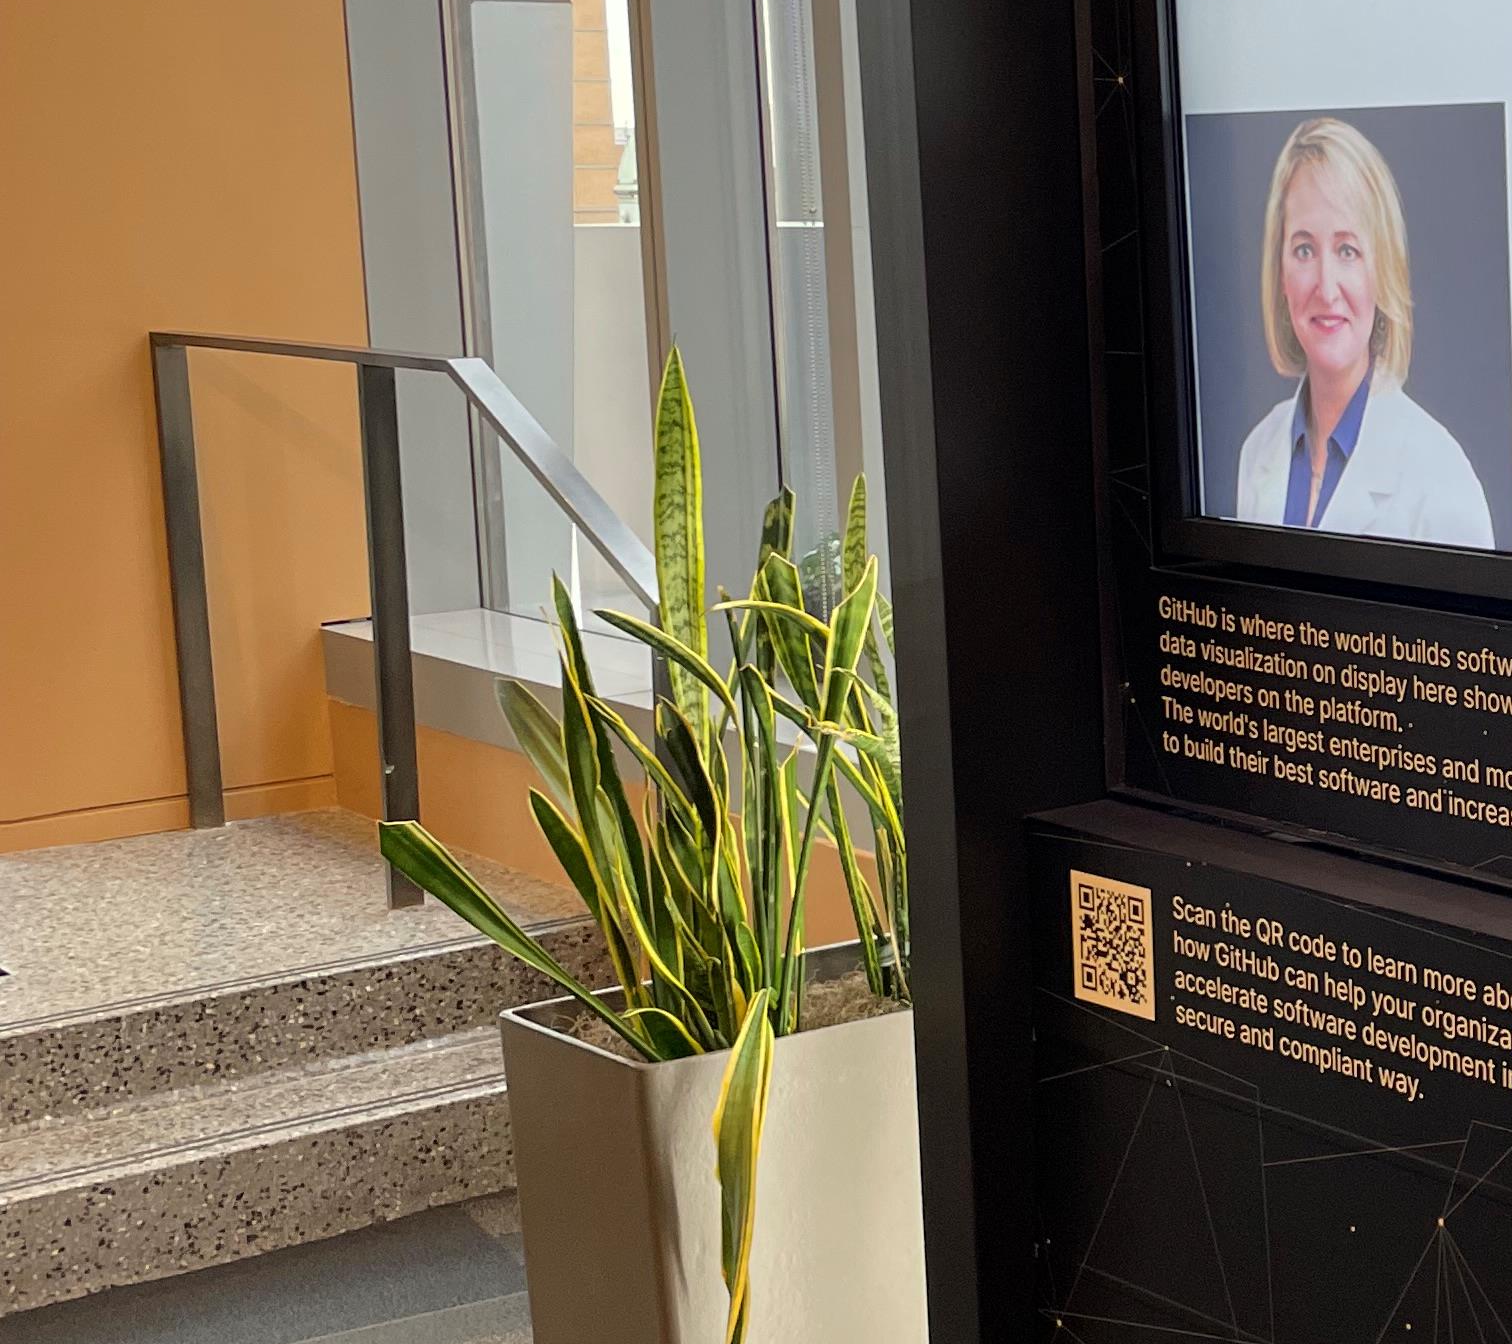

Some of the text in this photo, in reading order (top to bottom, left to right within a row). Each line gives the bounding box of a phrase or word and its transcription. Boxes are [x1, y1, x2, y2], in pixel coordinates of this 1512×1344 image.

[1159, 595, 1217, 628] GitHub
[1221, 608, 1235, 631] is
[1241, 613, 1295, 643] where
[1299, 622, 1329, 647] the
[1335, 630, 1386, 658] world
[1392, 635, 1451, 667] builds
[1159, 631, 1196, 659] data
[1200, 638, 1308, 680] visualization
[1312, 660, 1336, 685] on
[1340, 664, 1407, 702] display
[1413, 675, 1457, 706] here
[1160, 664, 1403, 733] developers on the platform.
[1161, 696, 1194, 724] The
[1198, 706, 1259, 739] world's
[1263, 717, 1324, 753] largest
[1329, 735, 1437, 775] enterprises
[1442, 756, 1479, 784] and
[1163, 731, 1180, 754] to
[1184, 735, 1225, 765] build
[1229, 747, 1270, 775] their
[1274, 754, 1313, 786] best
[1318, 768, 1401, 805] software
[1406, 786, 1443, 814] and
[1172, 895, 1216, 929] Scan
[1221, 906, 1252, 938] the
[1256, 917, 1284, 948] QR
[1289, 930, 1336, 961] code
[1342, 942, 1362, 969] to
[1367, 948, 1417, 984] learn
[1423, 968, 1477, 1000] more
[1173, 931, 1211, 962] how
[1215, 942, 1280, 981] GitHub
[1284, 966, 1318, 994] can
[1324, 972, 1366, 1010] help
[1371, 991, 1416, 1021] your
[1174, 970, 1268, 1013] accelerate
[1274, 998, 1357, 1040] software
[1362, 1022, 1496, 1084] development
[1175, 1005, 1424, 1102] secure and compliant way.
